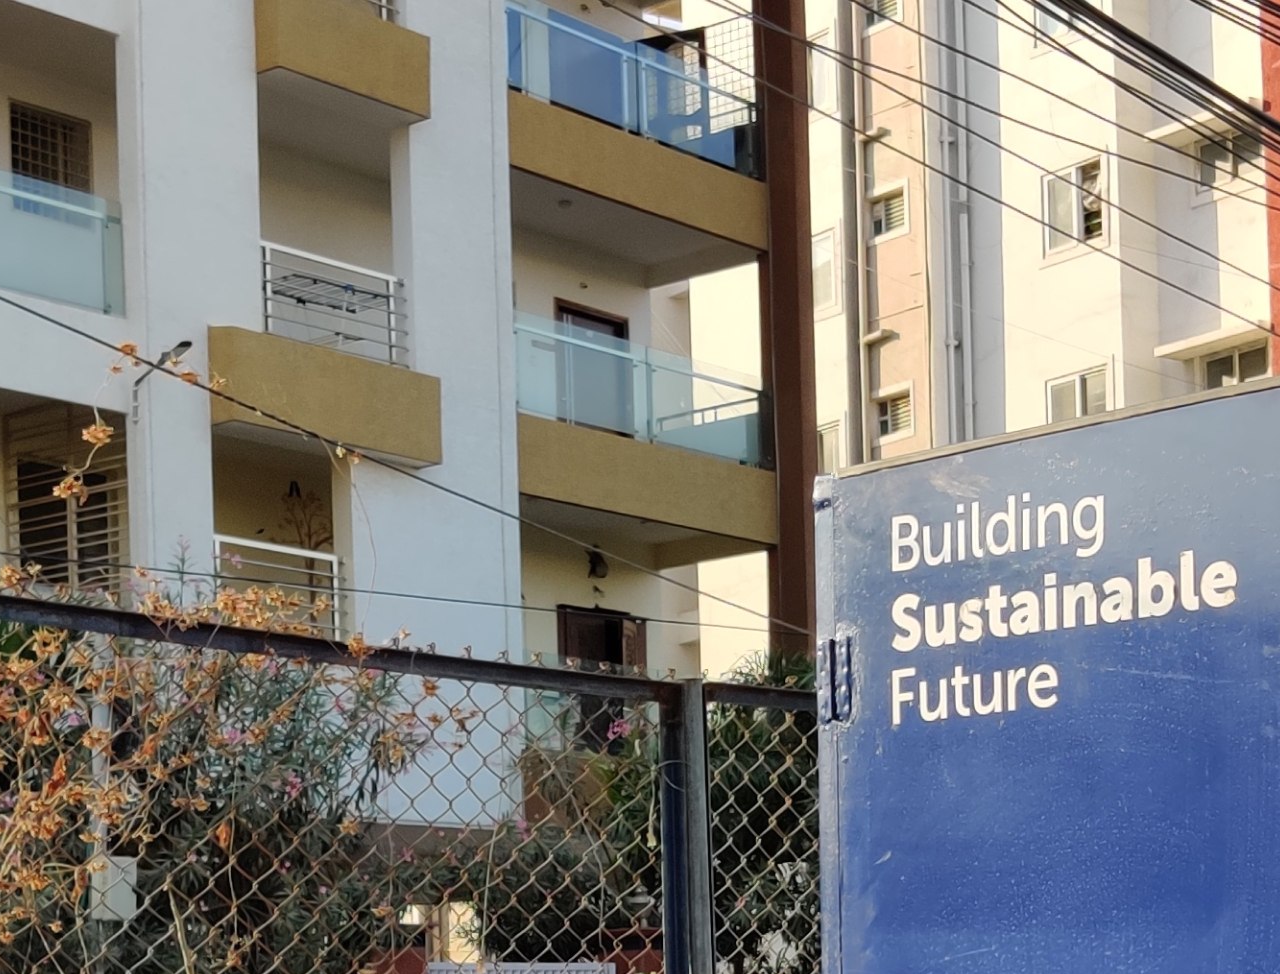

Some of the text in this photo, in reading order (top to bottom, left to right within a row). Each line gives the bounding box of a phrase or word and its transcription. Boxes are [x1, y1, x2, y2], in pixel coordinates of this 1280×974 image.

[889, 492, 1106, 573] Building
[889, 549, 1239, 653] Sustainable
[889, 662, 1060, 726] Future
